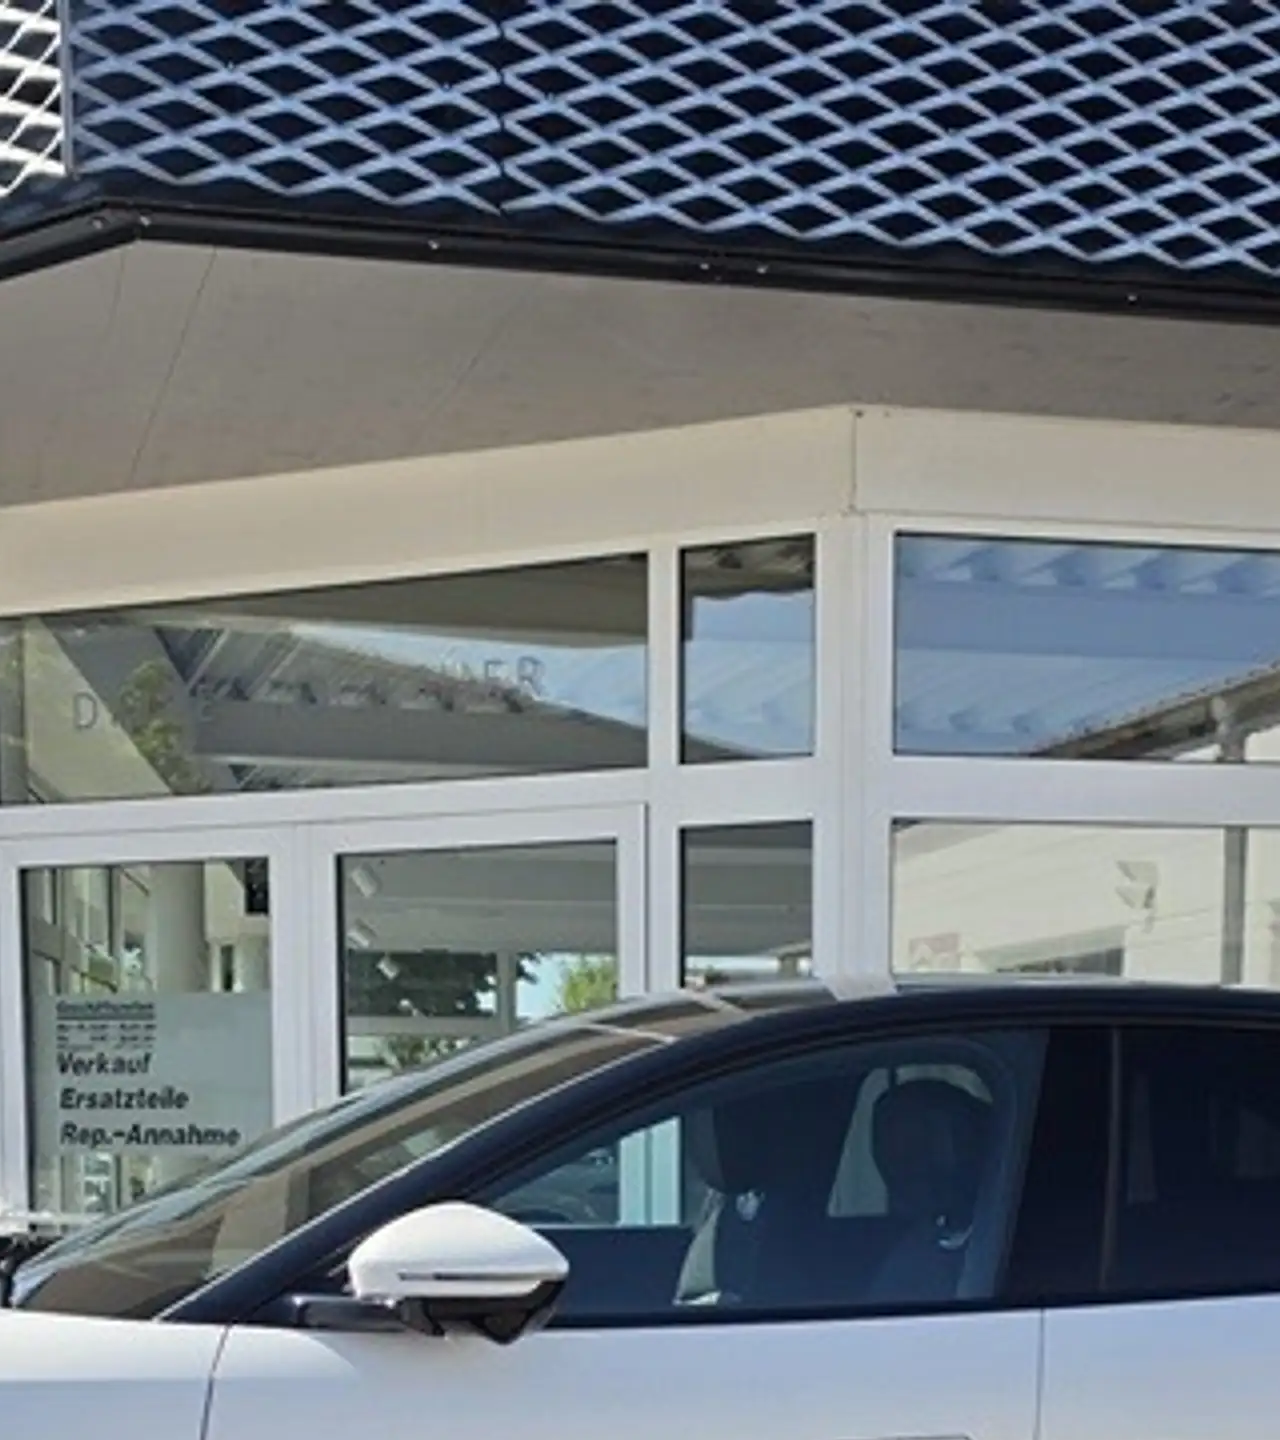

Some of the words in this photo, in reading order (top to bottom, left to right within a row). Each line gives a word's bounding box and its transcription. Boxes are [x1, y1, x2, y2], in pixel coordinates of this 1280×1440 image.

[56, 1052, 152, 1076] Verkauf
[59, 1086, 190, 1110] Ersatzteile
[60, 1120, 241, 1149] Rep.-Annahme
